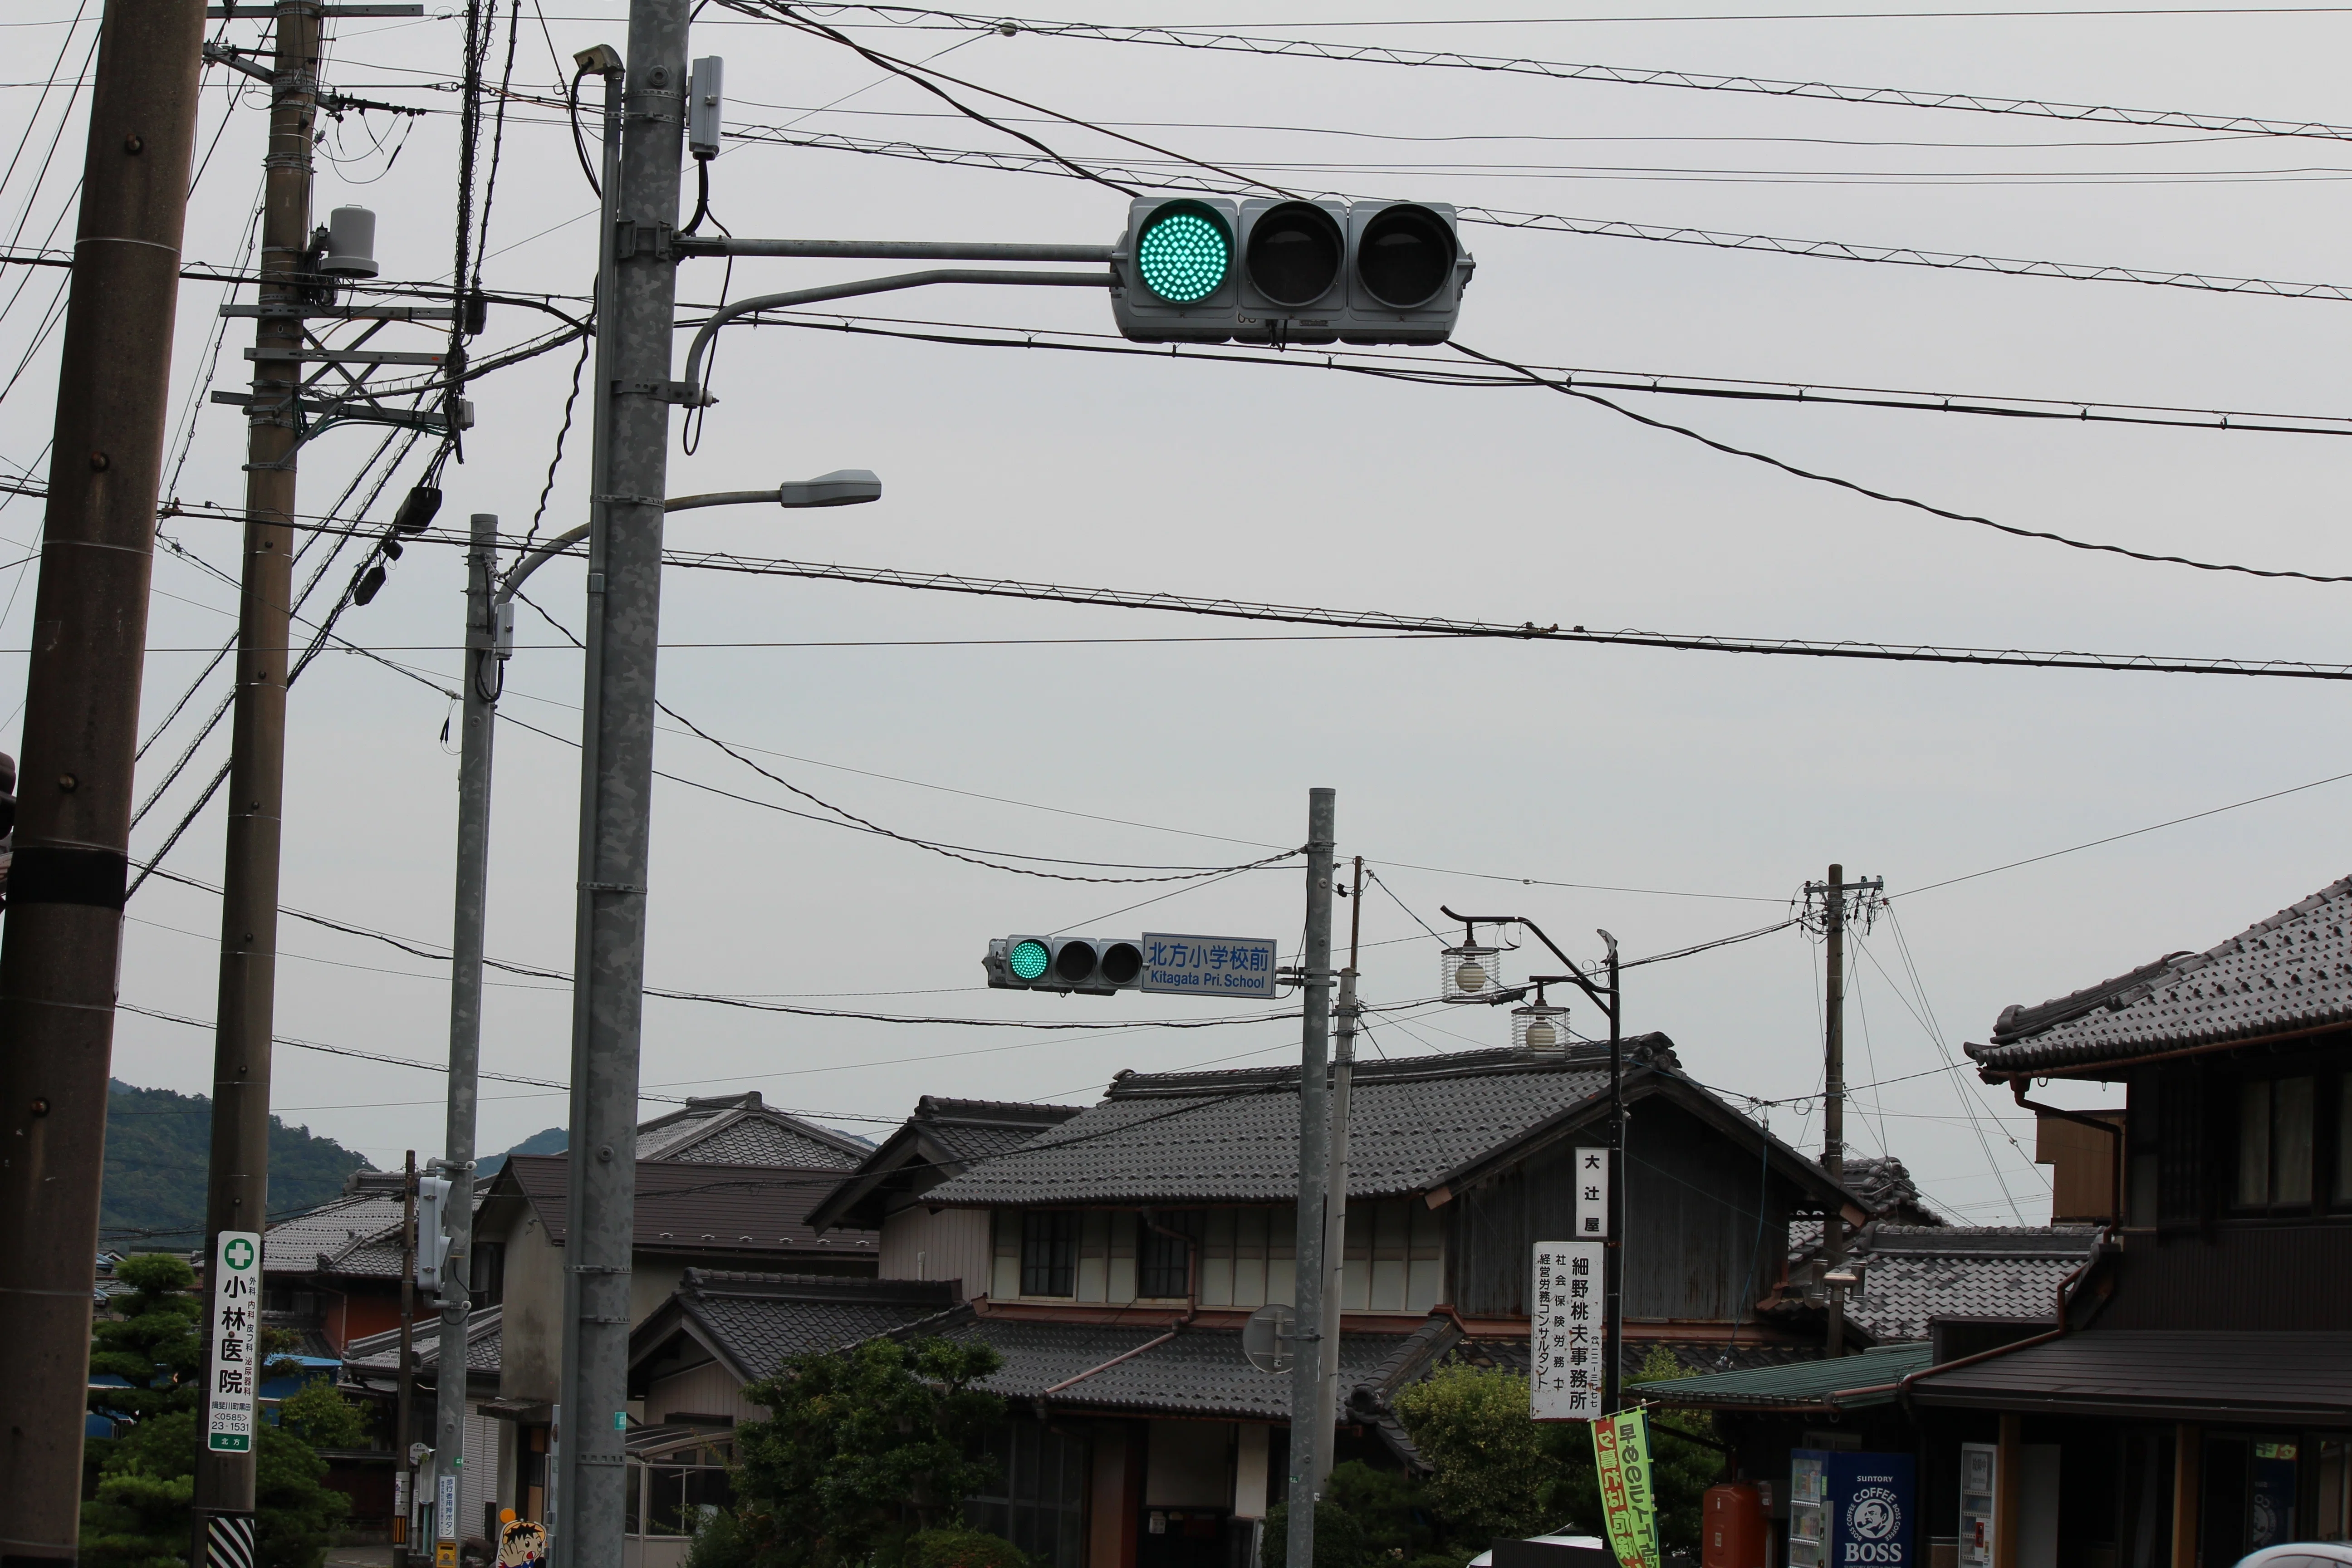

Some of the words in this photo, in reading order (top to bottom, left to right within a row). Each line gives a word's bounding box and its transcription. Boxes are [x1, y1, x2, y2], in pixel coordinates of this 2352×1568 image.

[1148, 941, 1269, 972] 北方小学校前
[1151, 970, 1199, 987] Kitagata
[1204, 973, 1222, 987] Pri.
[1224, 975, 1264, 989] School
[1584, 1154, 1600, 1232] 大辻屋
[248, 1276, 257, 1296] 外科
[247, 1300, 255, 1320] 内科
[1538, 1253, 1551, 1389] 経営労務コンサルタント
[1553, 1254, 1567, 1390] 社会保険労務士
[219, 1275, 247, 1394] 小林医院
[245, 1323, 254, 1352] 皮フ科
[1569, 1256, 1589, 1410] 細野桃夫事務所
[243, 1356, 253, 1396] 泌尿器科
[211, 1401, 251, 1411] 揖斐川町黒田
[445, 1479, 453, 1535] 歩行者用押ボタン
[1852, 1487, 1897, 1504] COFFEE
[1847, 1503, 1857, 1527] COFFEE
[1892, 1503, 1901, 1520] BOSS
[1849, 1526, 1862, 1542] BOSS
[1884, 1521, 1901, 1542] COFFEE
[1844, 1543, 1902, 1562] BOSS
